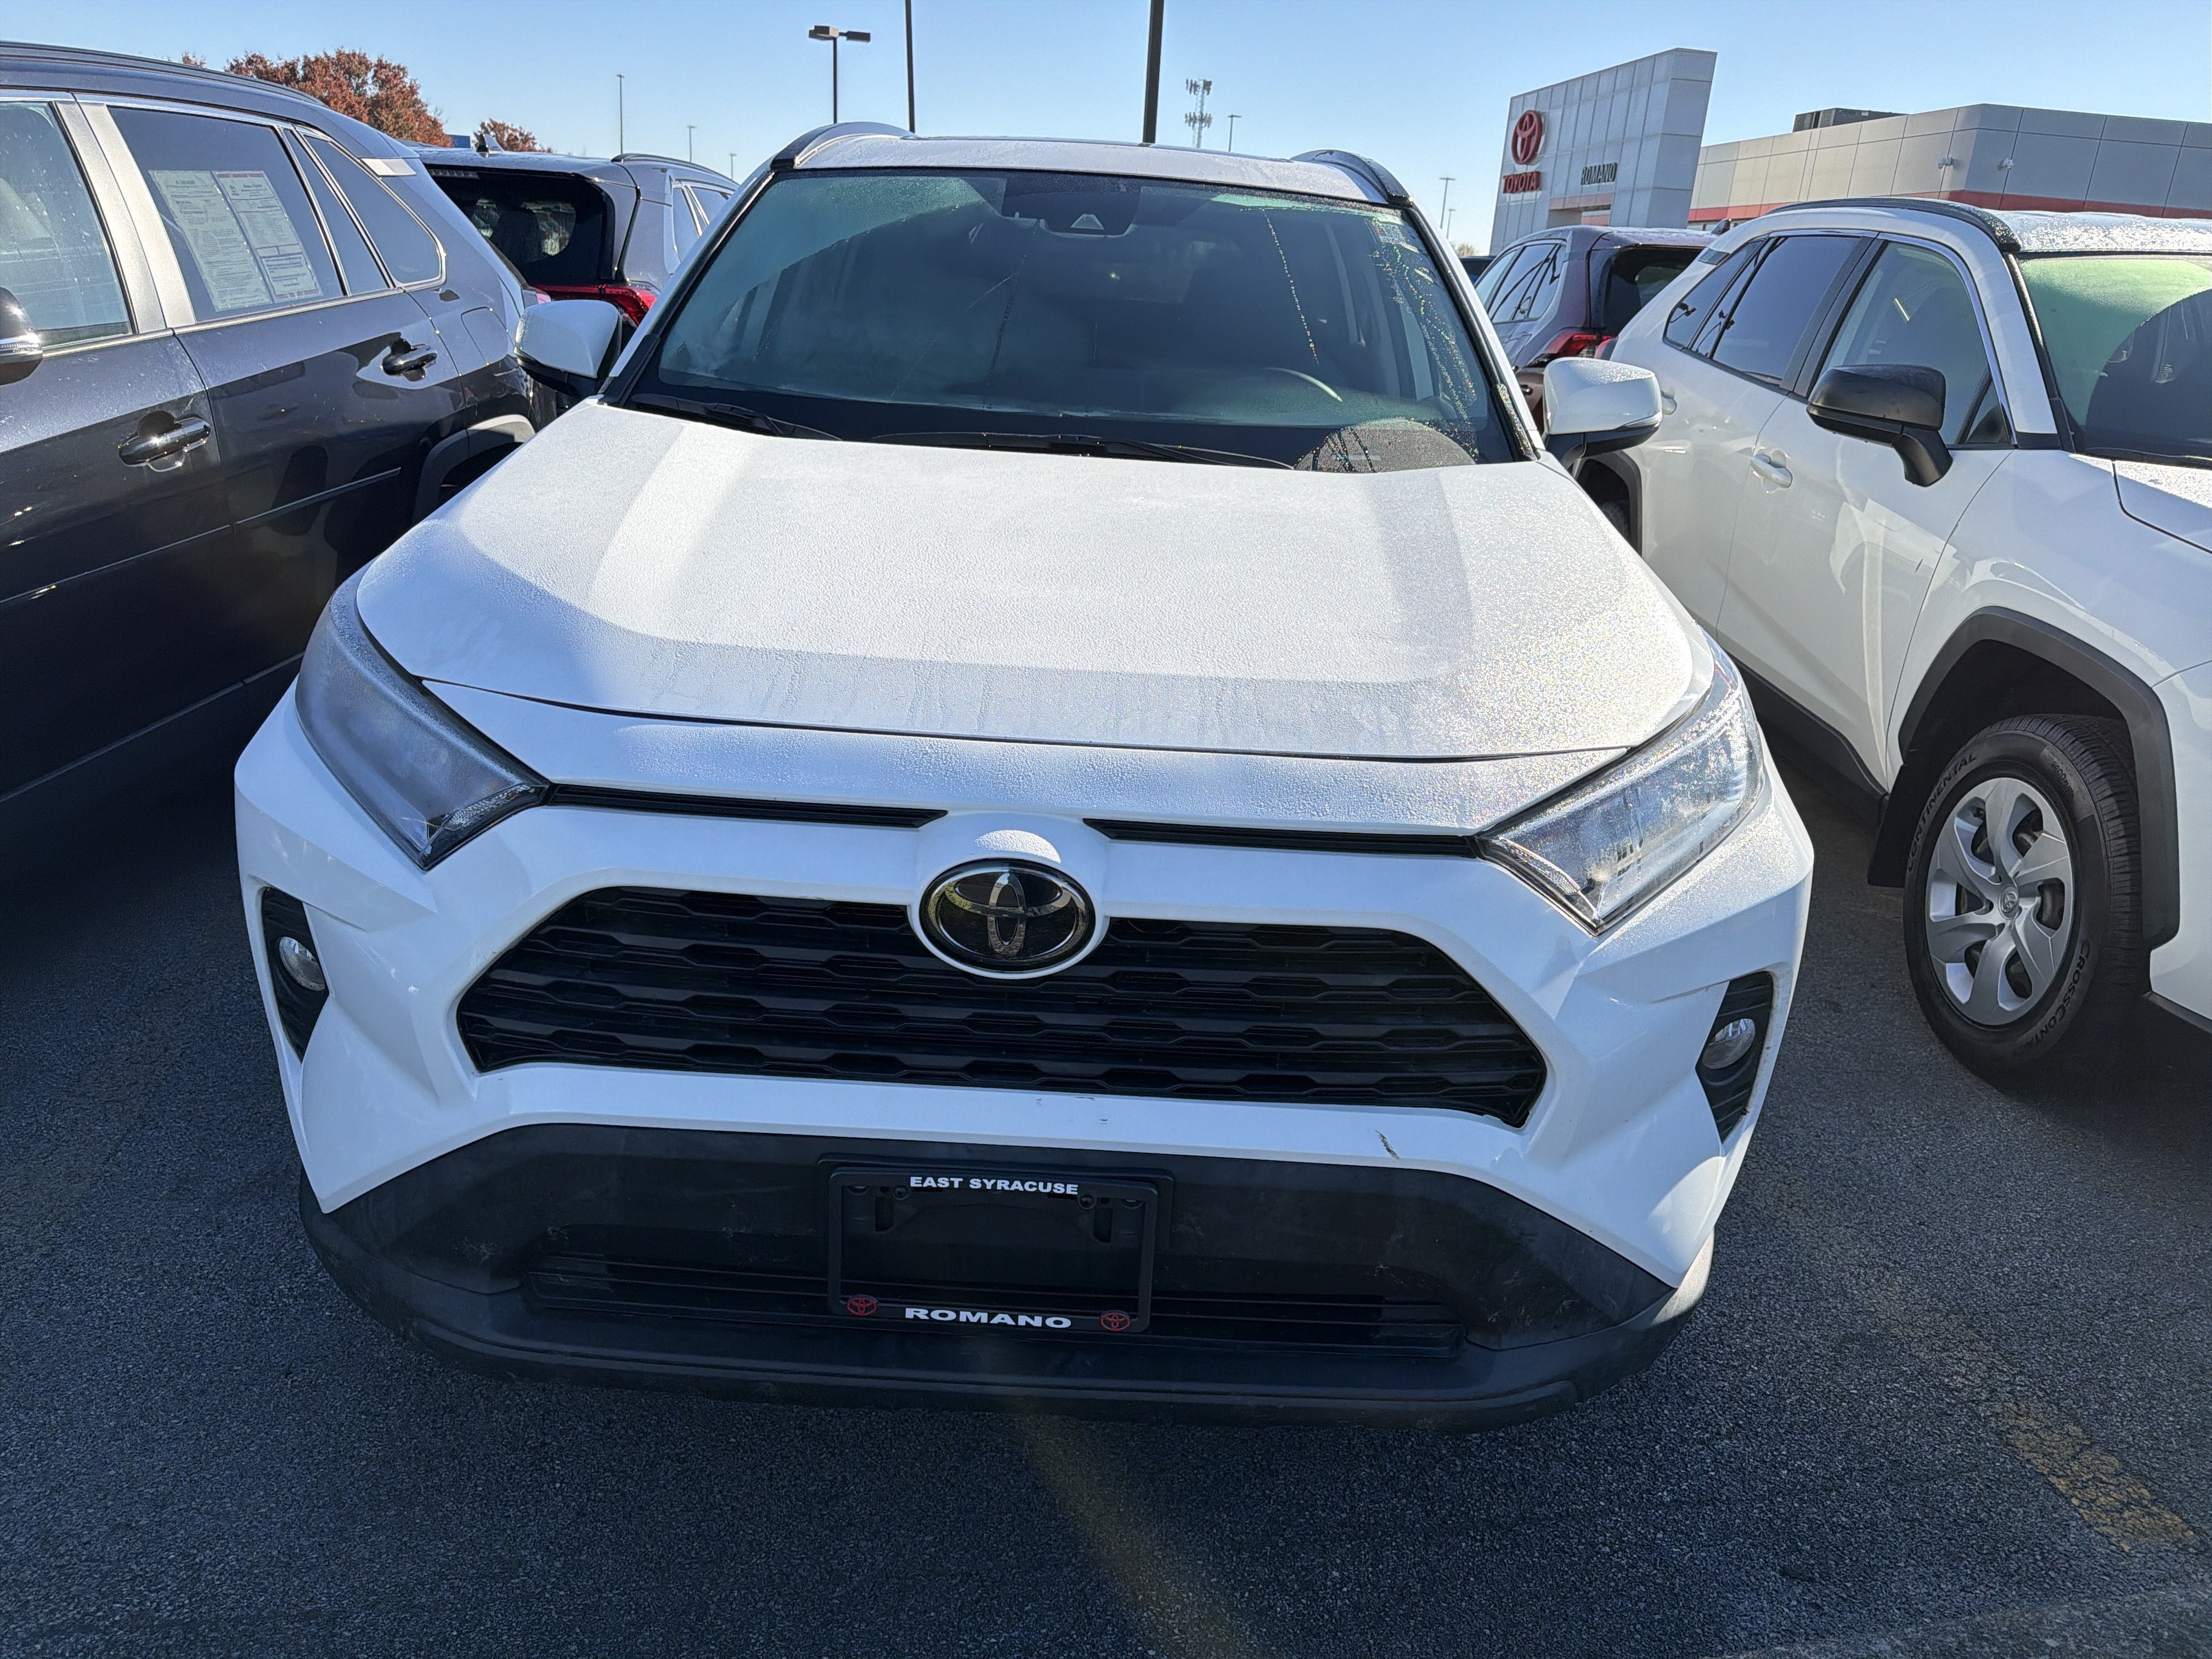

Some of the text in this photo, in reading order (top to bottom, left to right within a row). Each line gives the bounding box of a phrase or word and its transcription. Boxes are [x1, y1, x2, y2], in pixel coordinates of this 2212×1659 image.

[1503, 171, 1541, 193] TOYOTA
[1581, 162, 1617, 185] ROMANO
[1909, 753, 1976, 872] CONTINENTAL
[910, 1177, 1079, 1194] EAST SYRACUSE
[905, 1307, 1071, 1328] ROMANO
